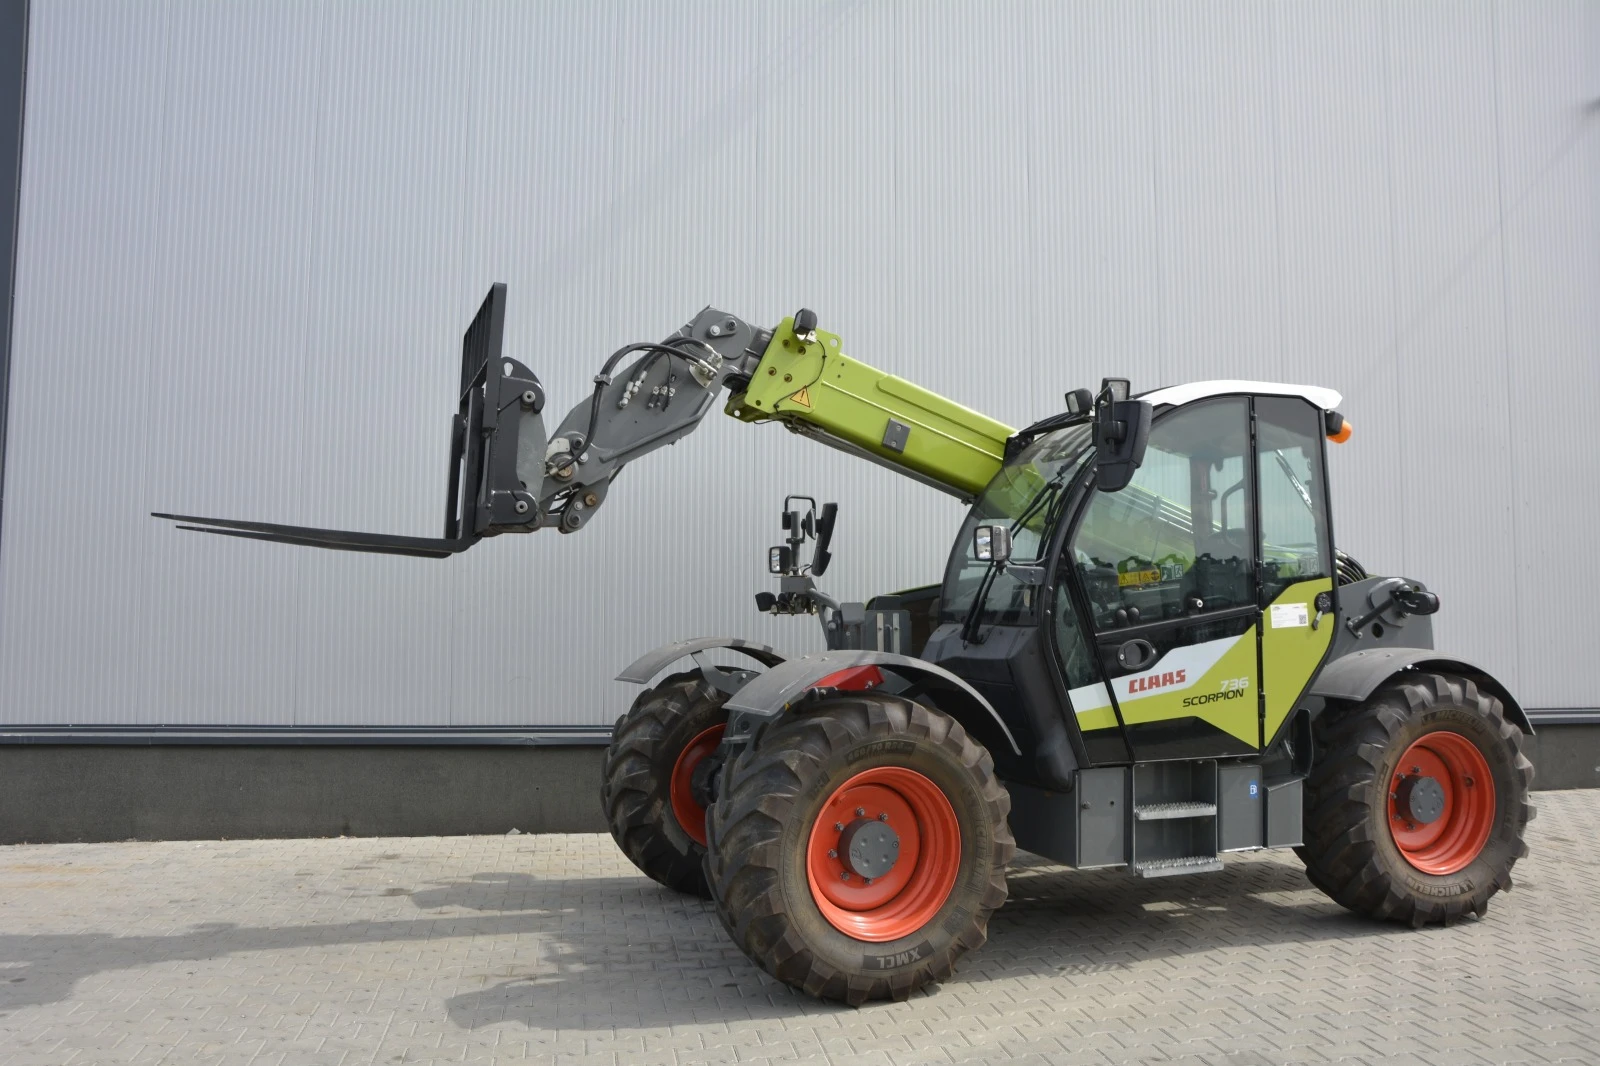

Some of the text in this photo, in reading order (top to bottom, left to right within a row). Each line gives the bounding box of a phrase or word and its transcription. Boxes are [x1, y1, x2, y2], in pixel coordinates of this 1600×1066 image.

[1129, 669, 1186, 693] CLAAS
[1220, 677, 1249, 691] 736
[1183, 688, 1244, 707] SCORPION
[1406, 877, 1461, 897] MICHELIN
[876, 947, 922, 969] XMCL
